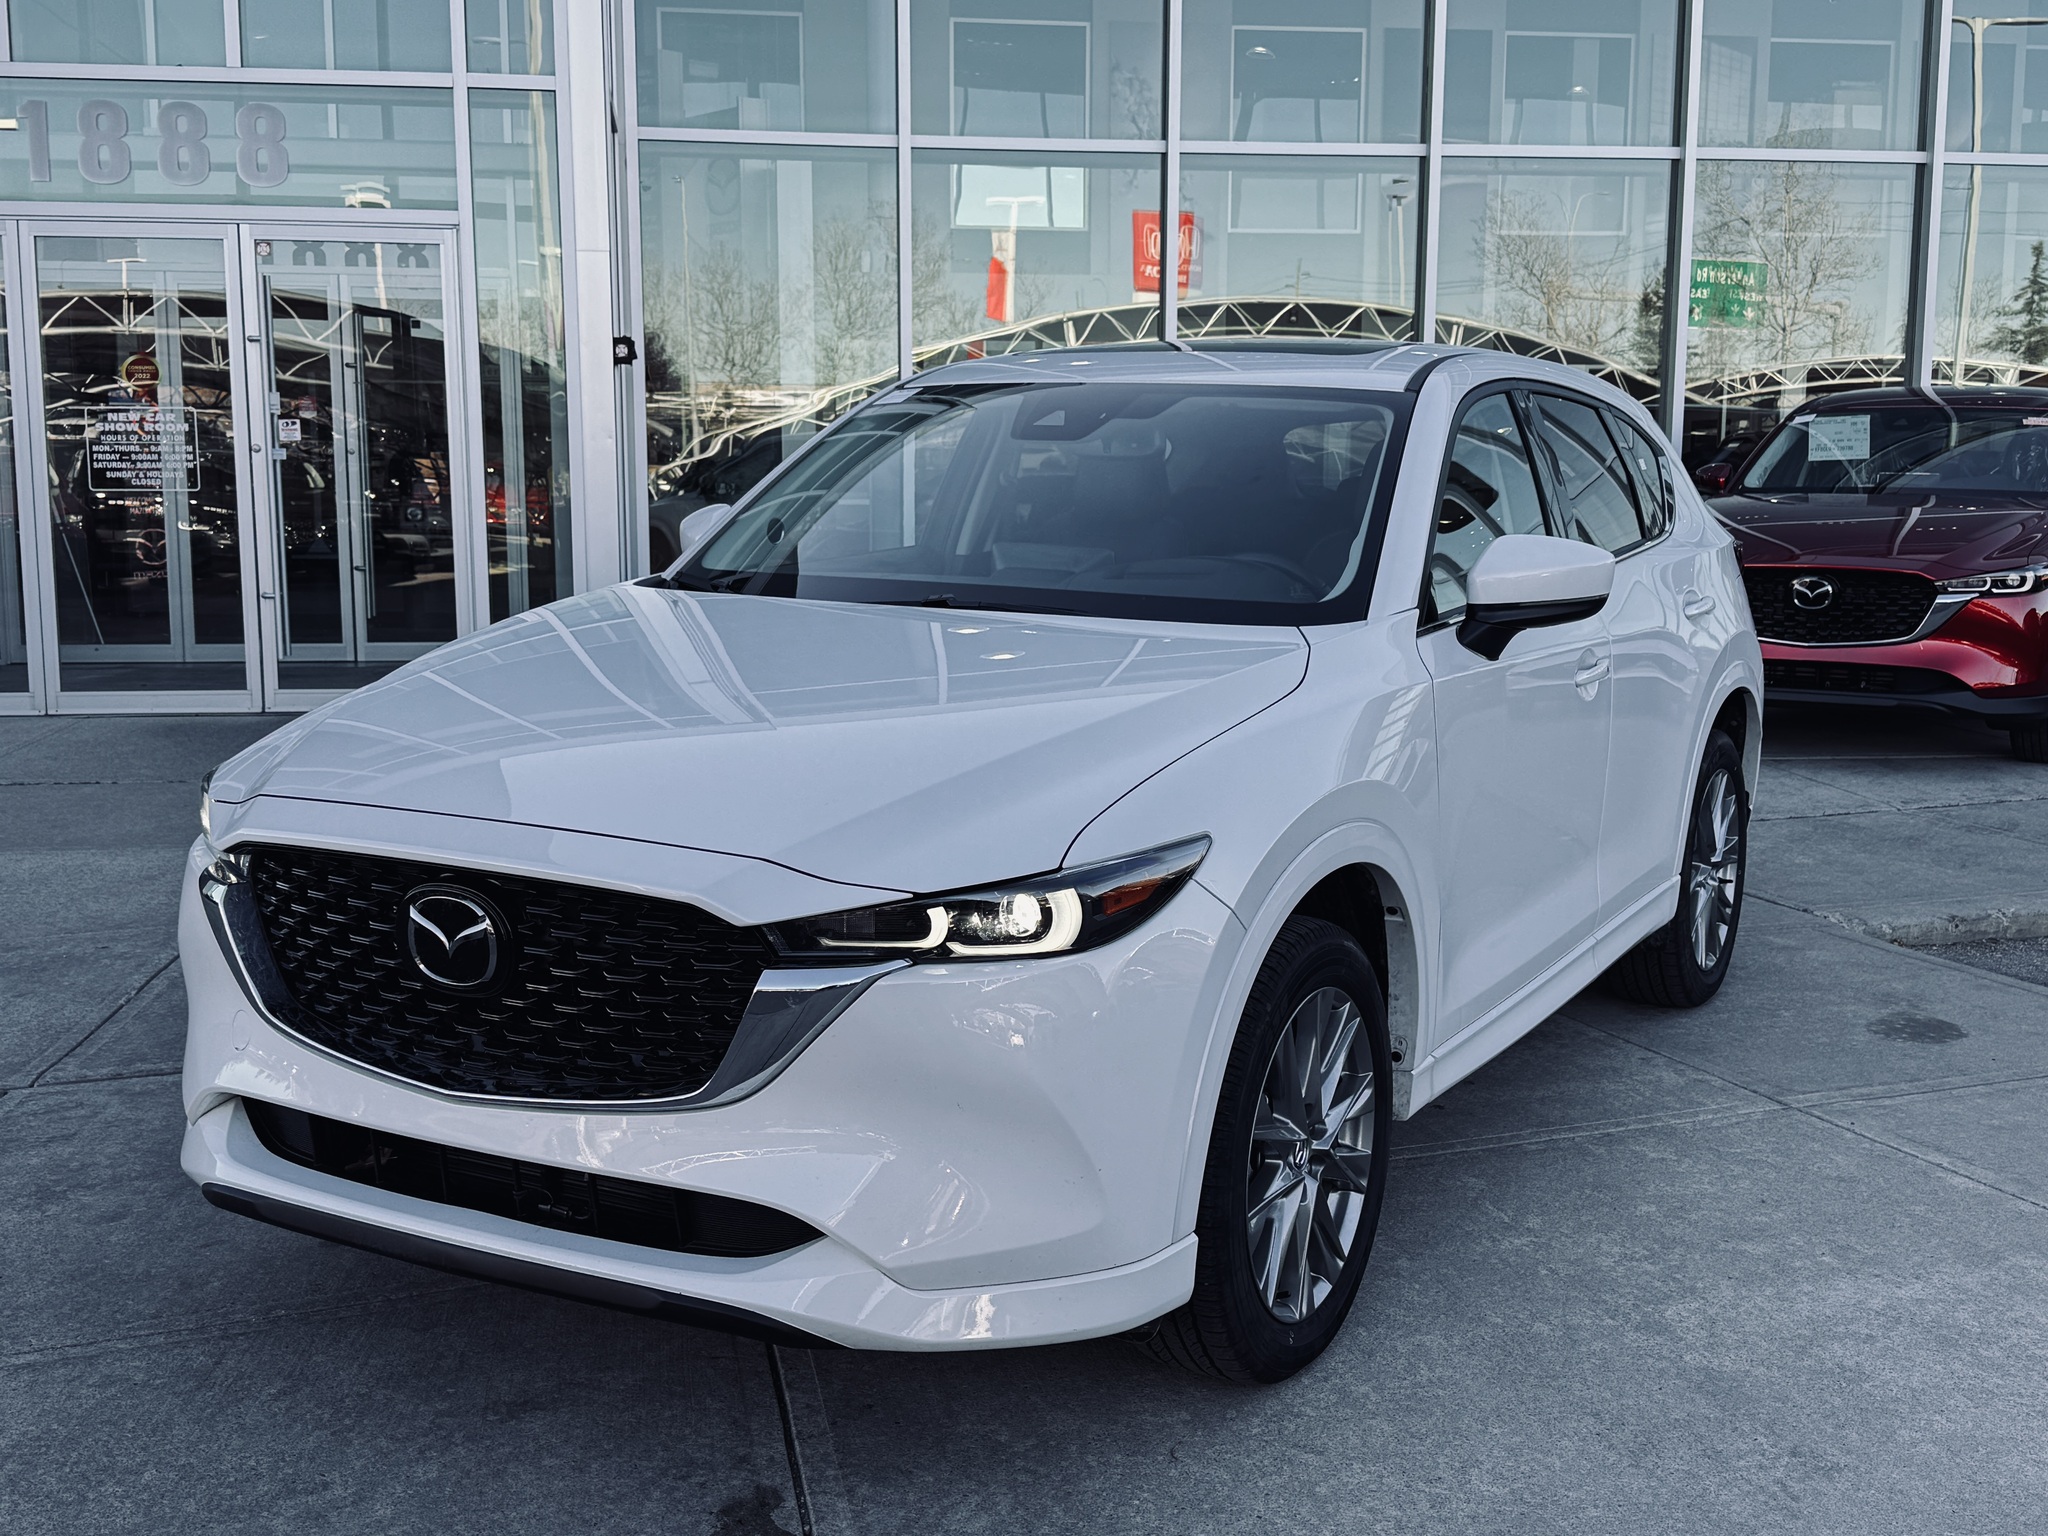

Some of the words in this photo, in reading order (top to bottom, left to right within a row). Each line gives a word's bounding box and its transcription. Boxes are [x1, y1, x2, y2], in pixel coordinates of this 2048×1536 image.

[16, 99, 290, 188] 1888
[107, 412, 140, 422] NEW
[145, 413, 176, 422] CAR
[94, 423, 139, 432] SHOW
[144, 423, 189, 432] ROOM
